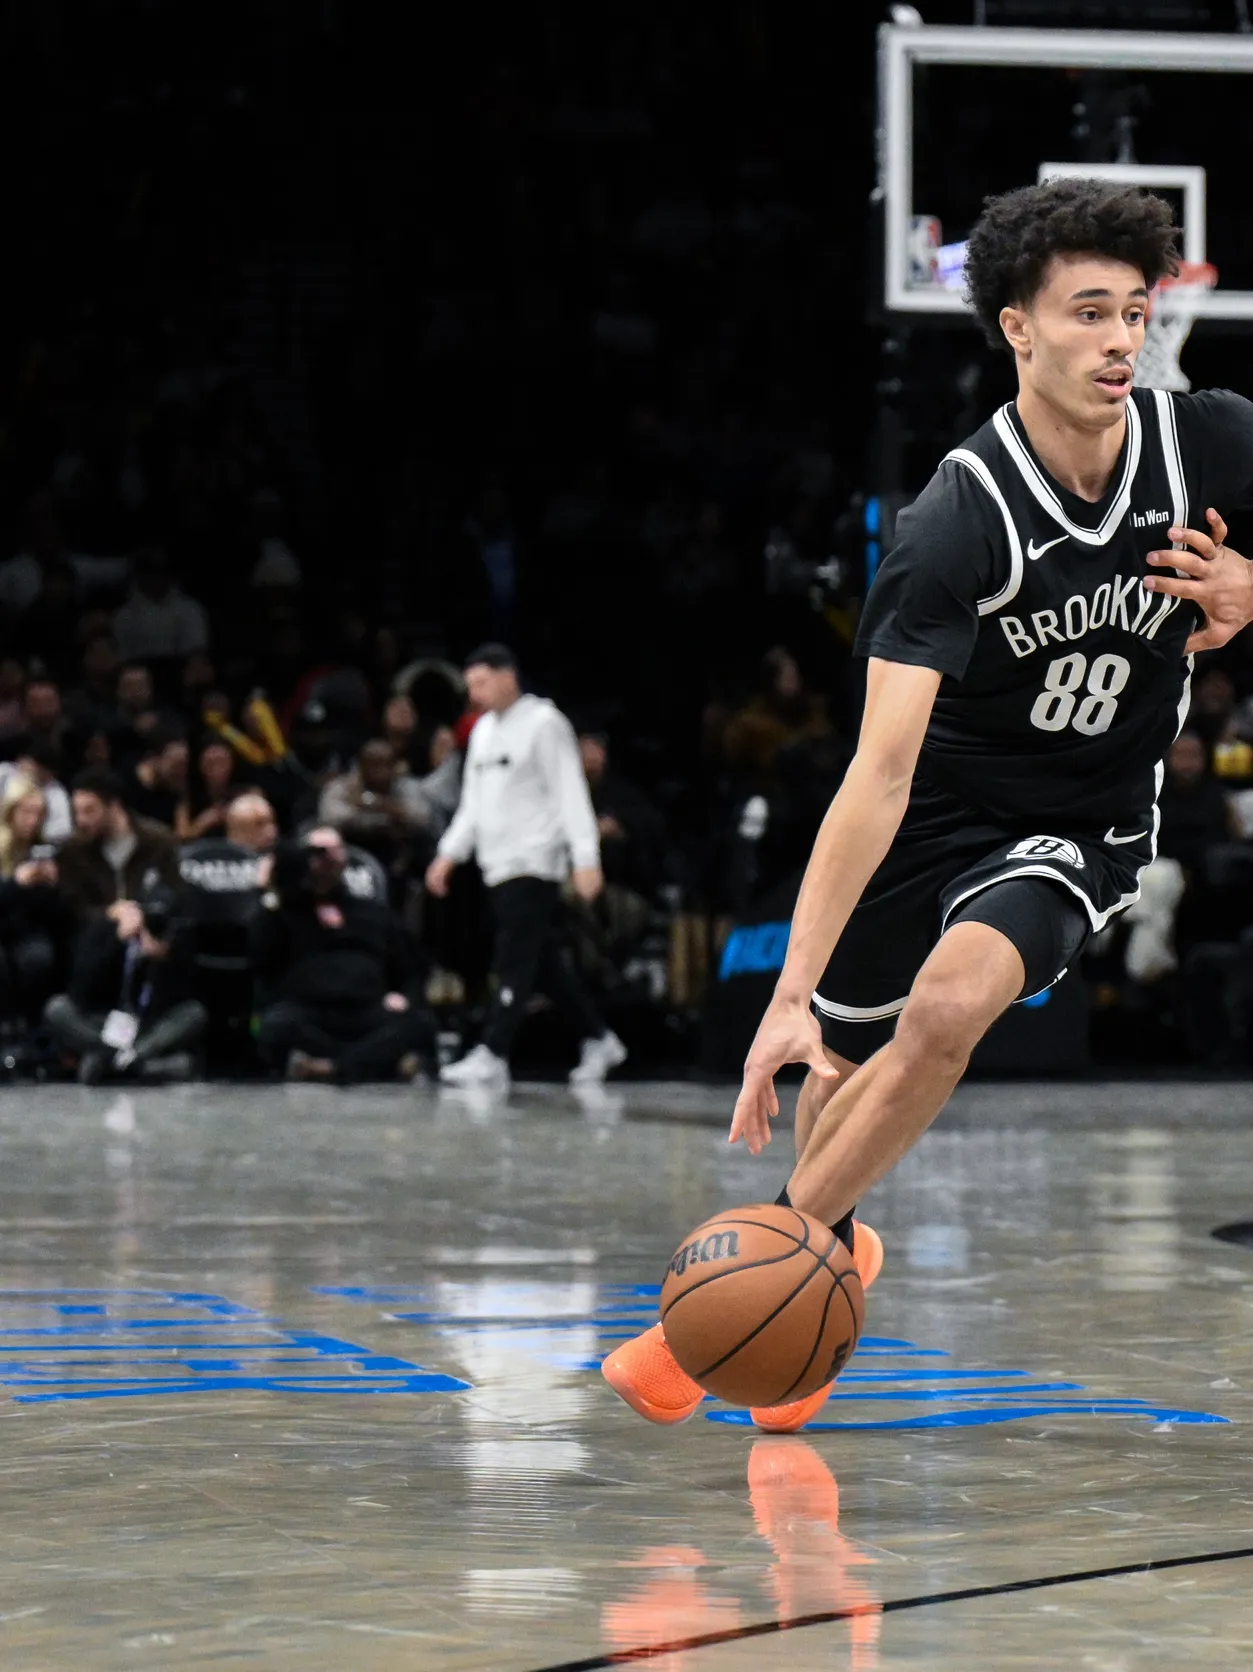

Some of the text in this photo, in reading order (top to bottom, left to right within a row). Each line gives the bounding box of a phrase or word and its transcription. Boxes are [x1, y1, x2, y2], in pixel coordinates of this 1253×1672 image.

[1133, 512, 1146, 528] In
[1146, 509, 1170, 526] Won
[999, 573, 1182, 658] BROOKYN
[1030, 652, 1131, 737] 88
